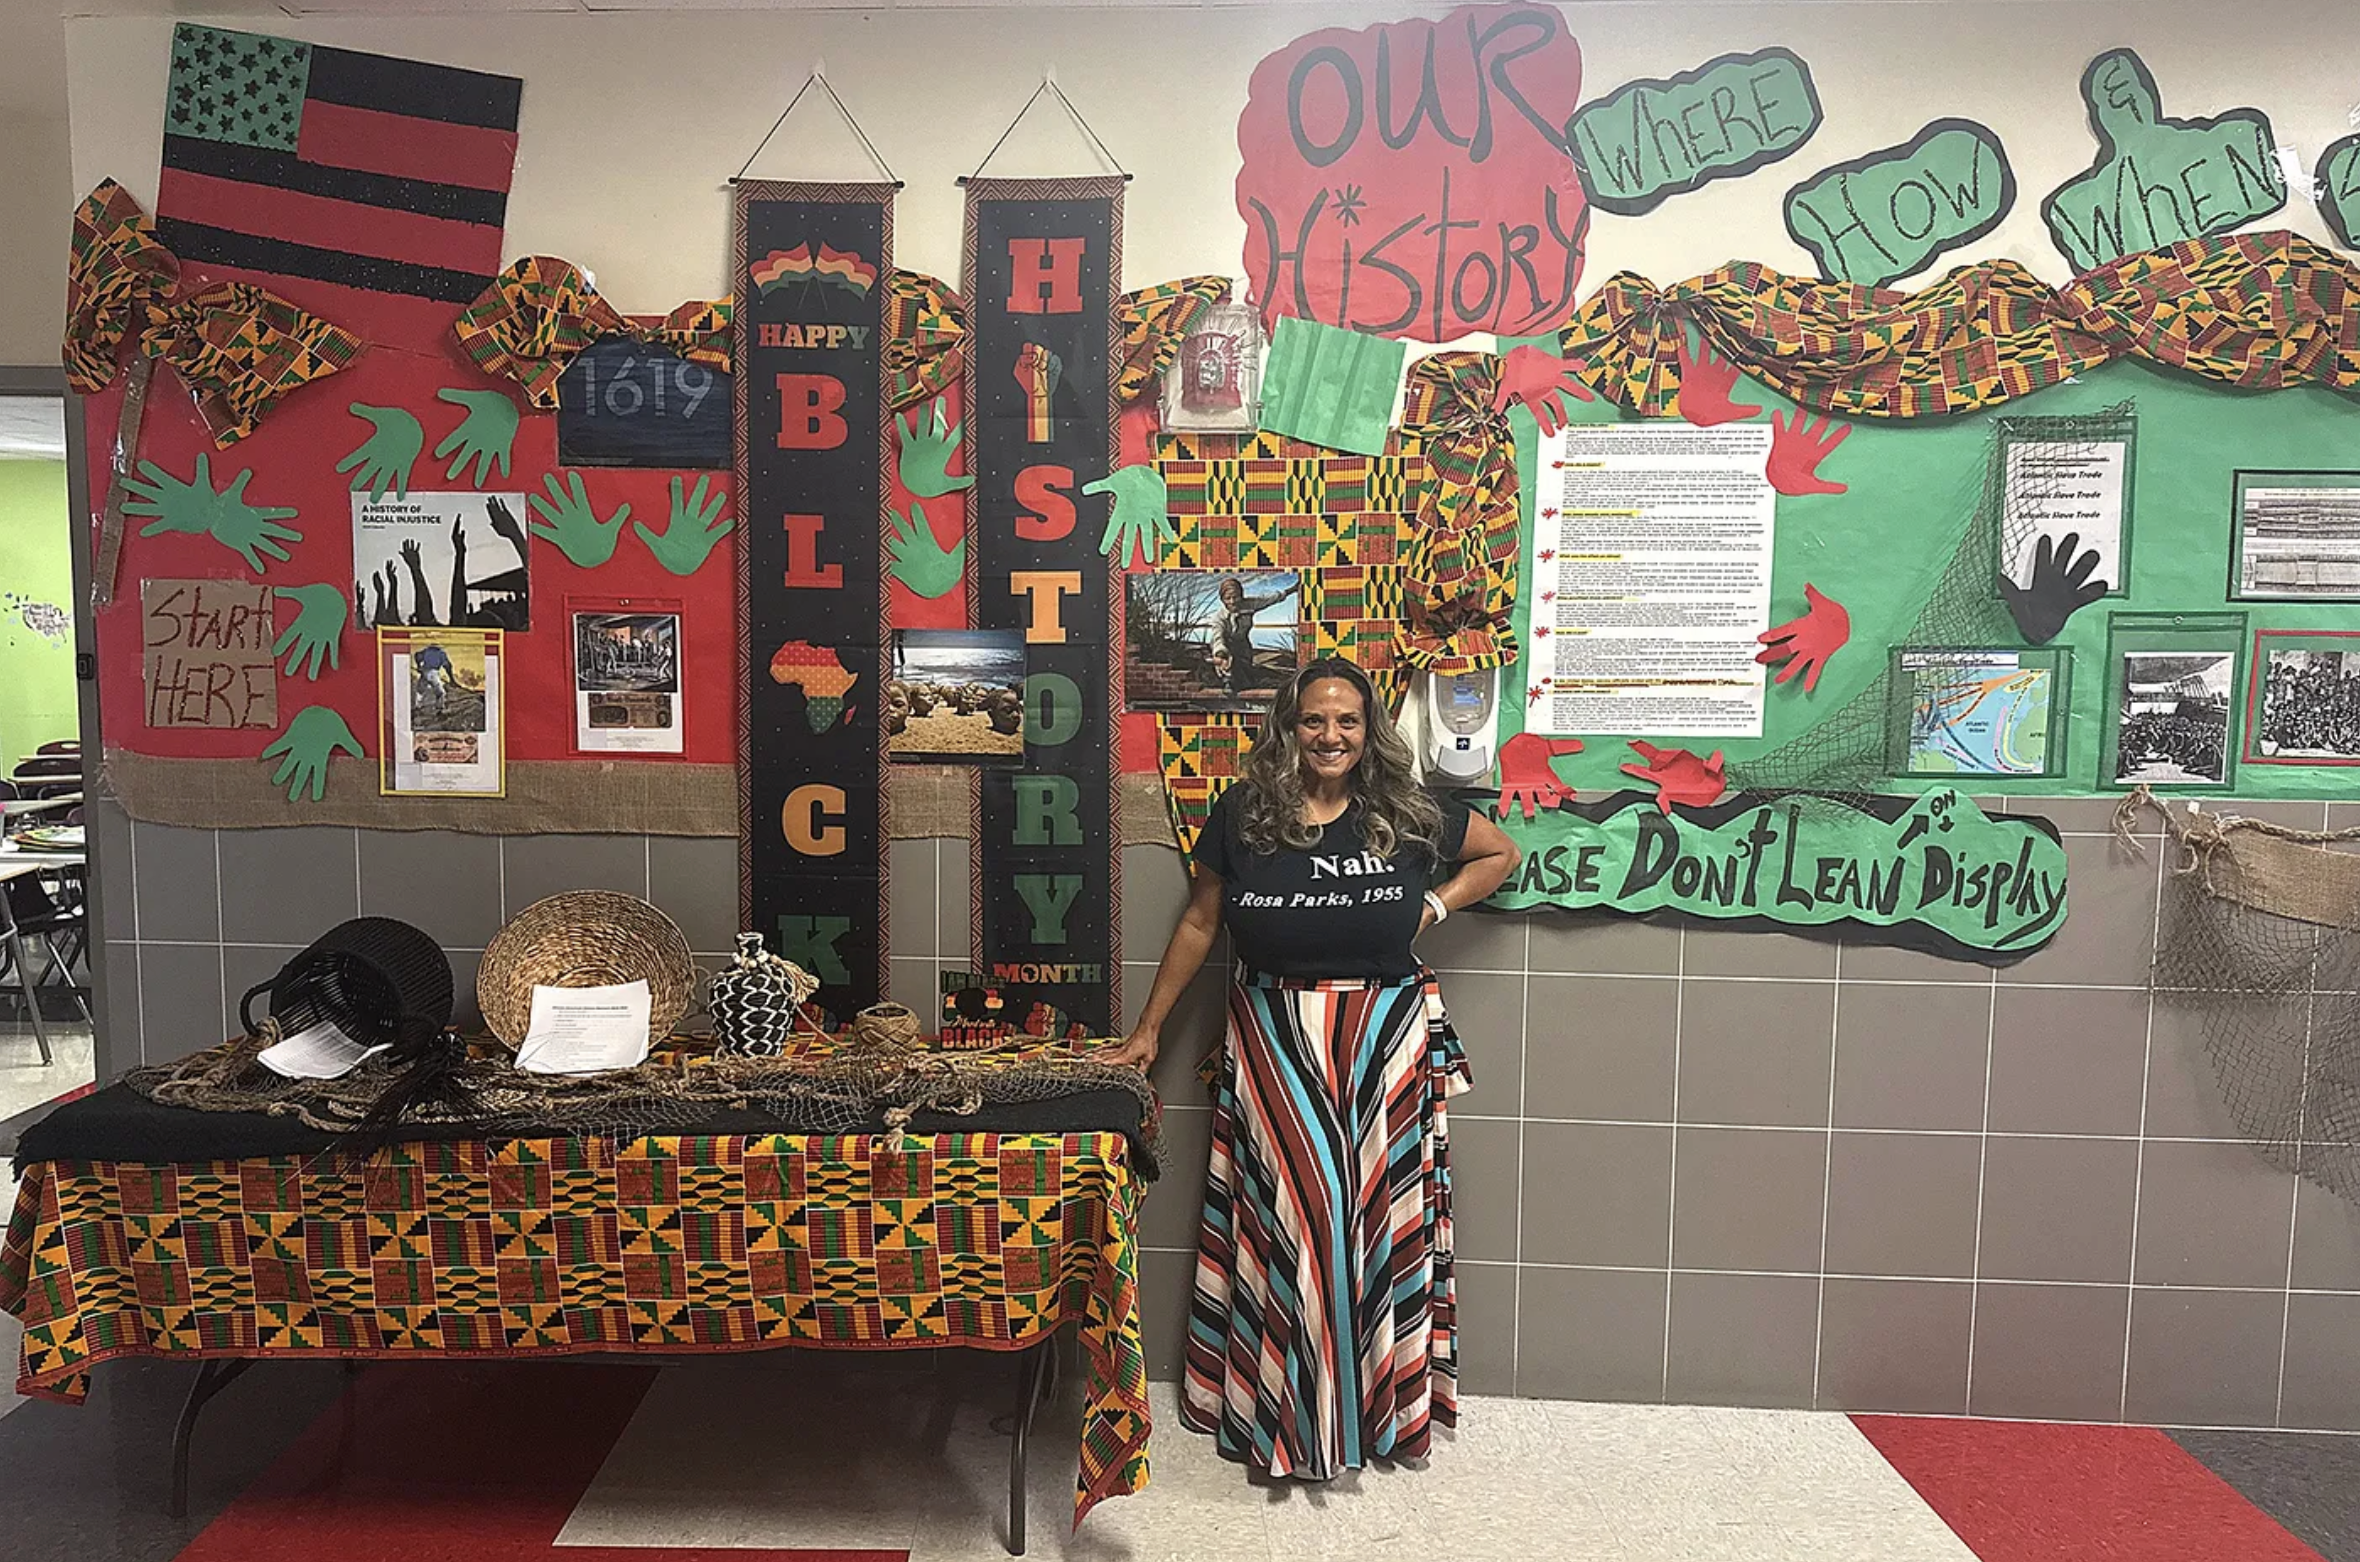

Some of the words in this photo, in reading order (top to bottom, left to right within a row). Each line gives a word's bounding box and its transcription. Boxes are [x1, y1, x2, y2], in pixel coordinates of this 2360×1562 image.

[1796, 137, 1981, 282] HOW
[758, 323, 870, 349] HAPPY
[577, 356, 714, 419] 1619
[362, 505, 369, 513] A
[370, 505, 409, 513] HISTORY
[410, 505, 422, 513] OF
[362, 515, 395, 523] RACIAL
[397, 515, 441, 524] INJUSTICE
[1309, 851, 1396, 880] Nah.
[1289, 891, 1354, 908] Parks,
[1361, 885, 1404, 904] 1955
[993, 963, 1102, 984] MONTH
